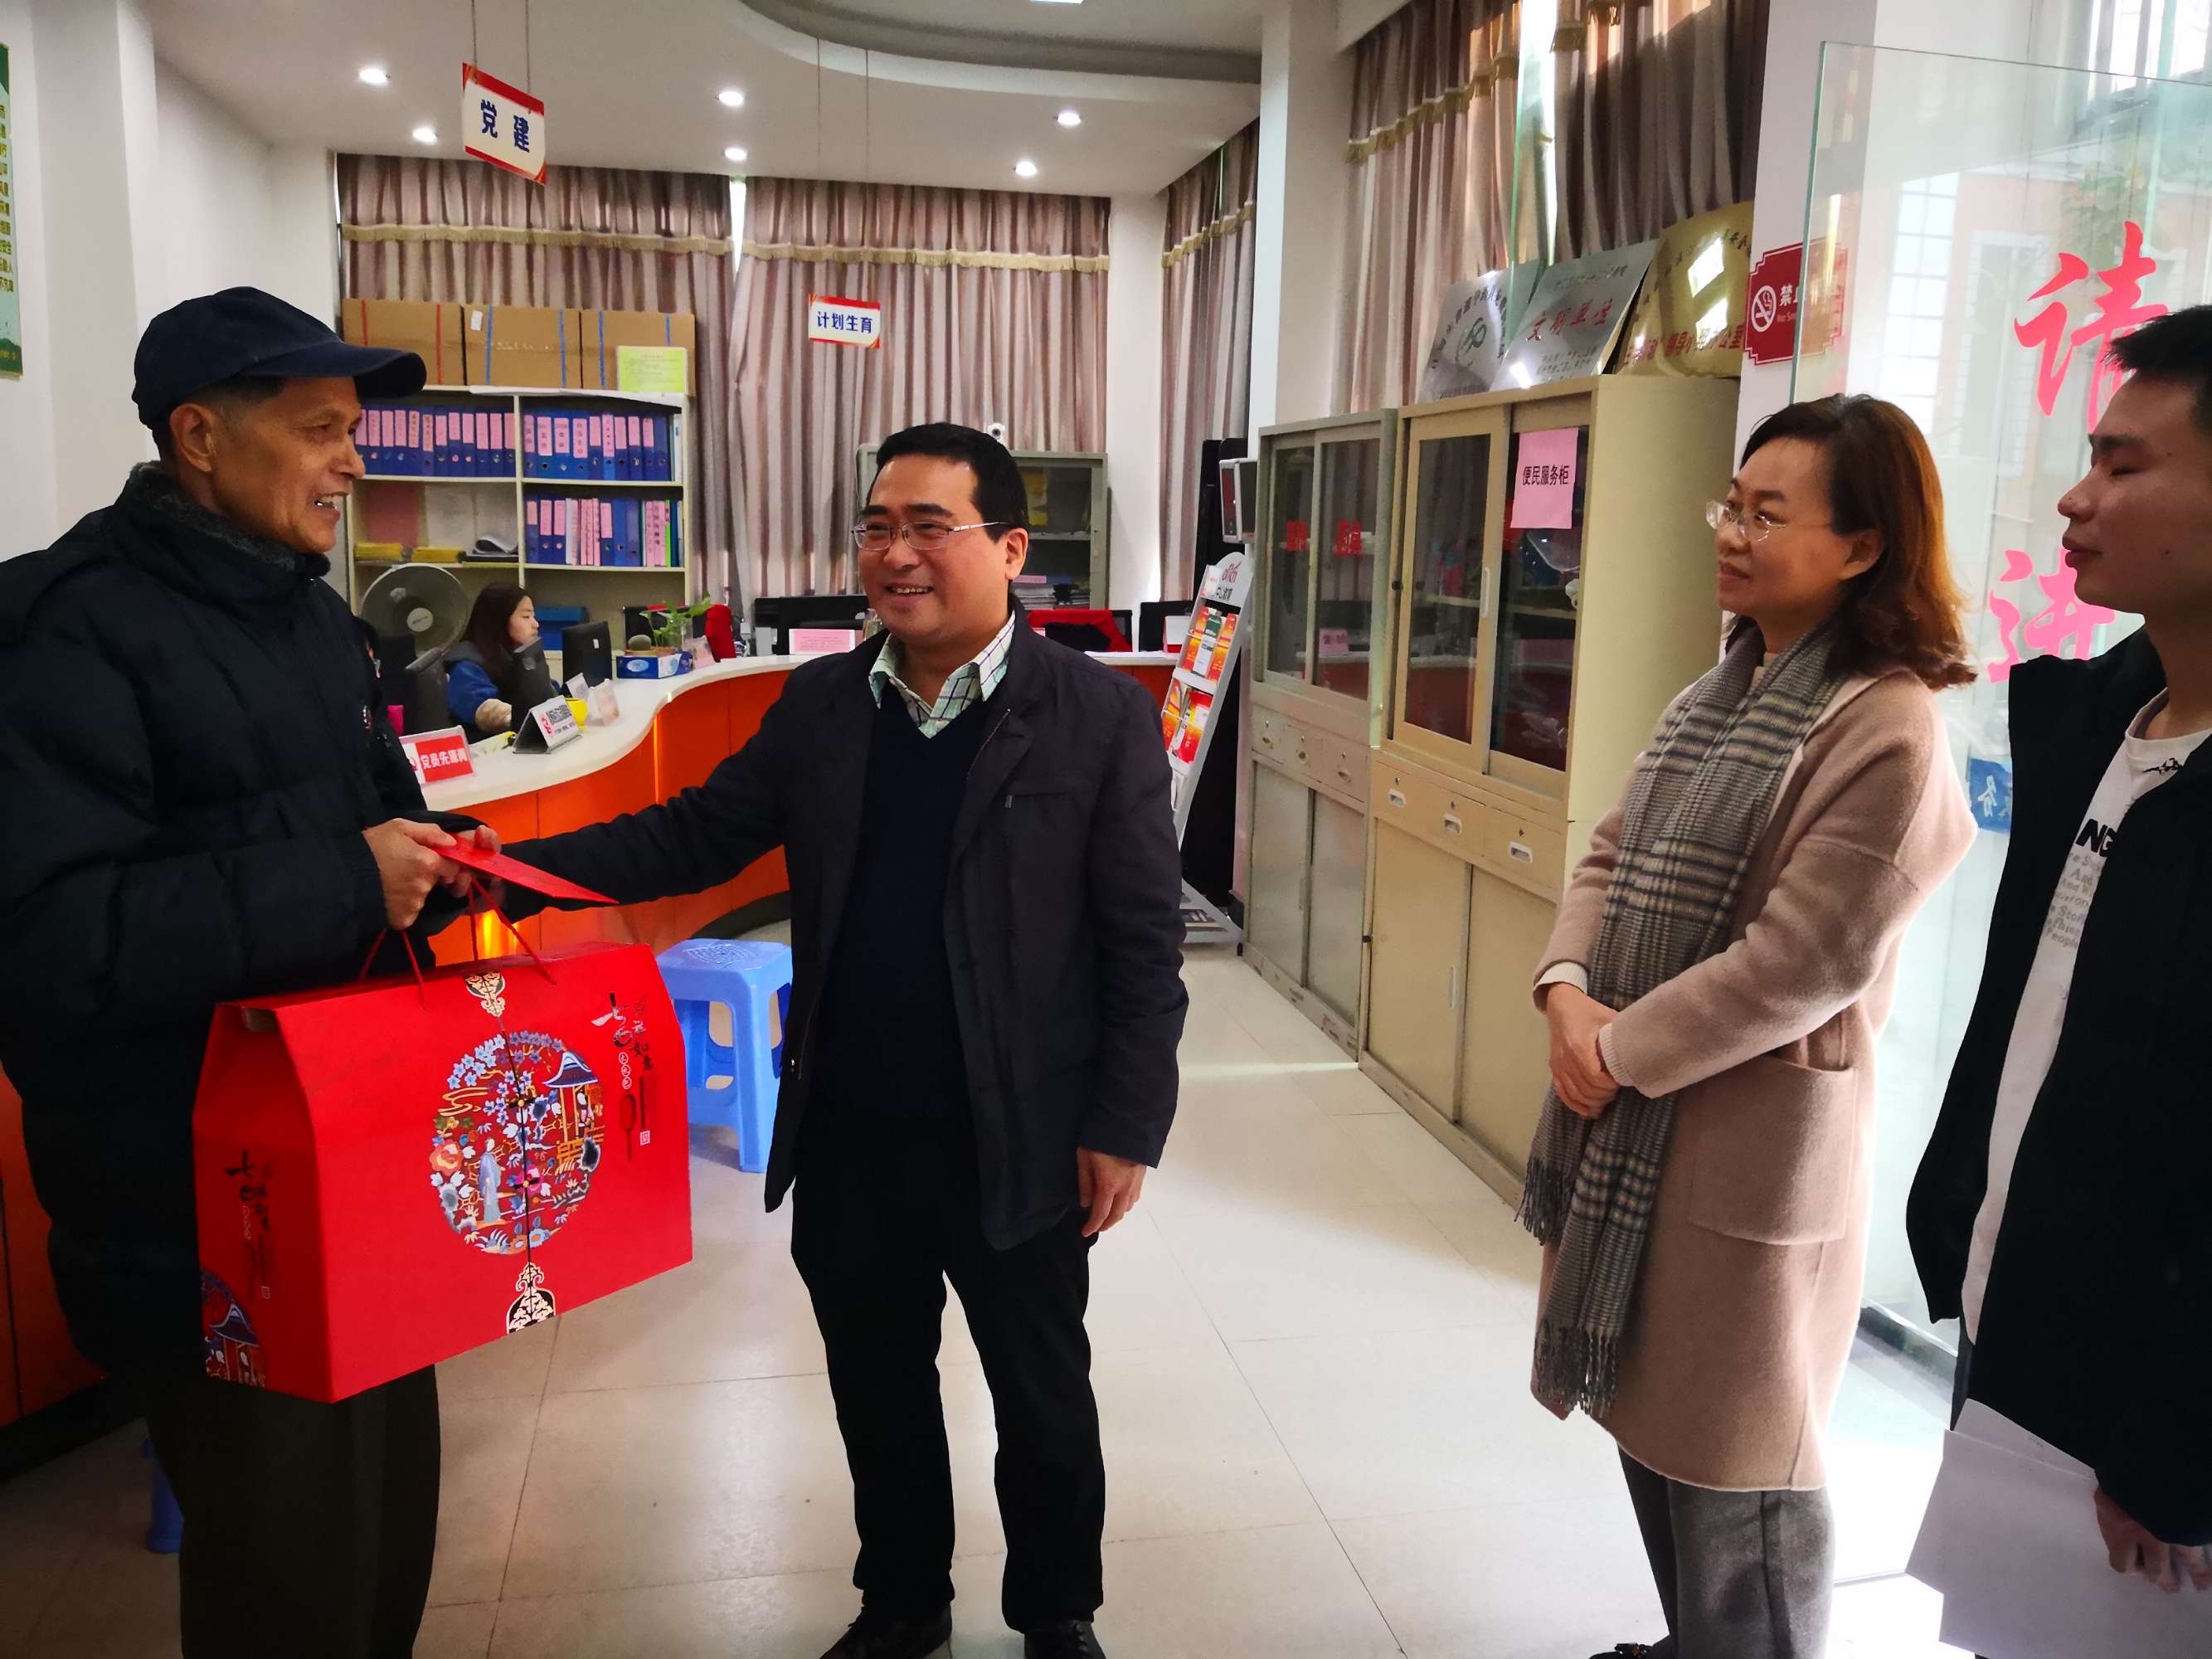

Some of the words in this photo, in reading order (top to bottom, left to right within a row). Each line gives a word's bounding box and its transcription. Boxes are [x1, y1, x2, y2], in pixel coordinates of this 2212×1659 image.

[480, 99, 530, 153] 党建
[817, 311, 873, 333] 计划生育
[1523, 465, 1569, 485] 便民服务柜
